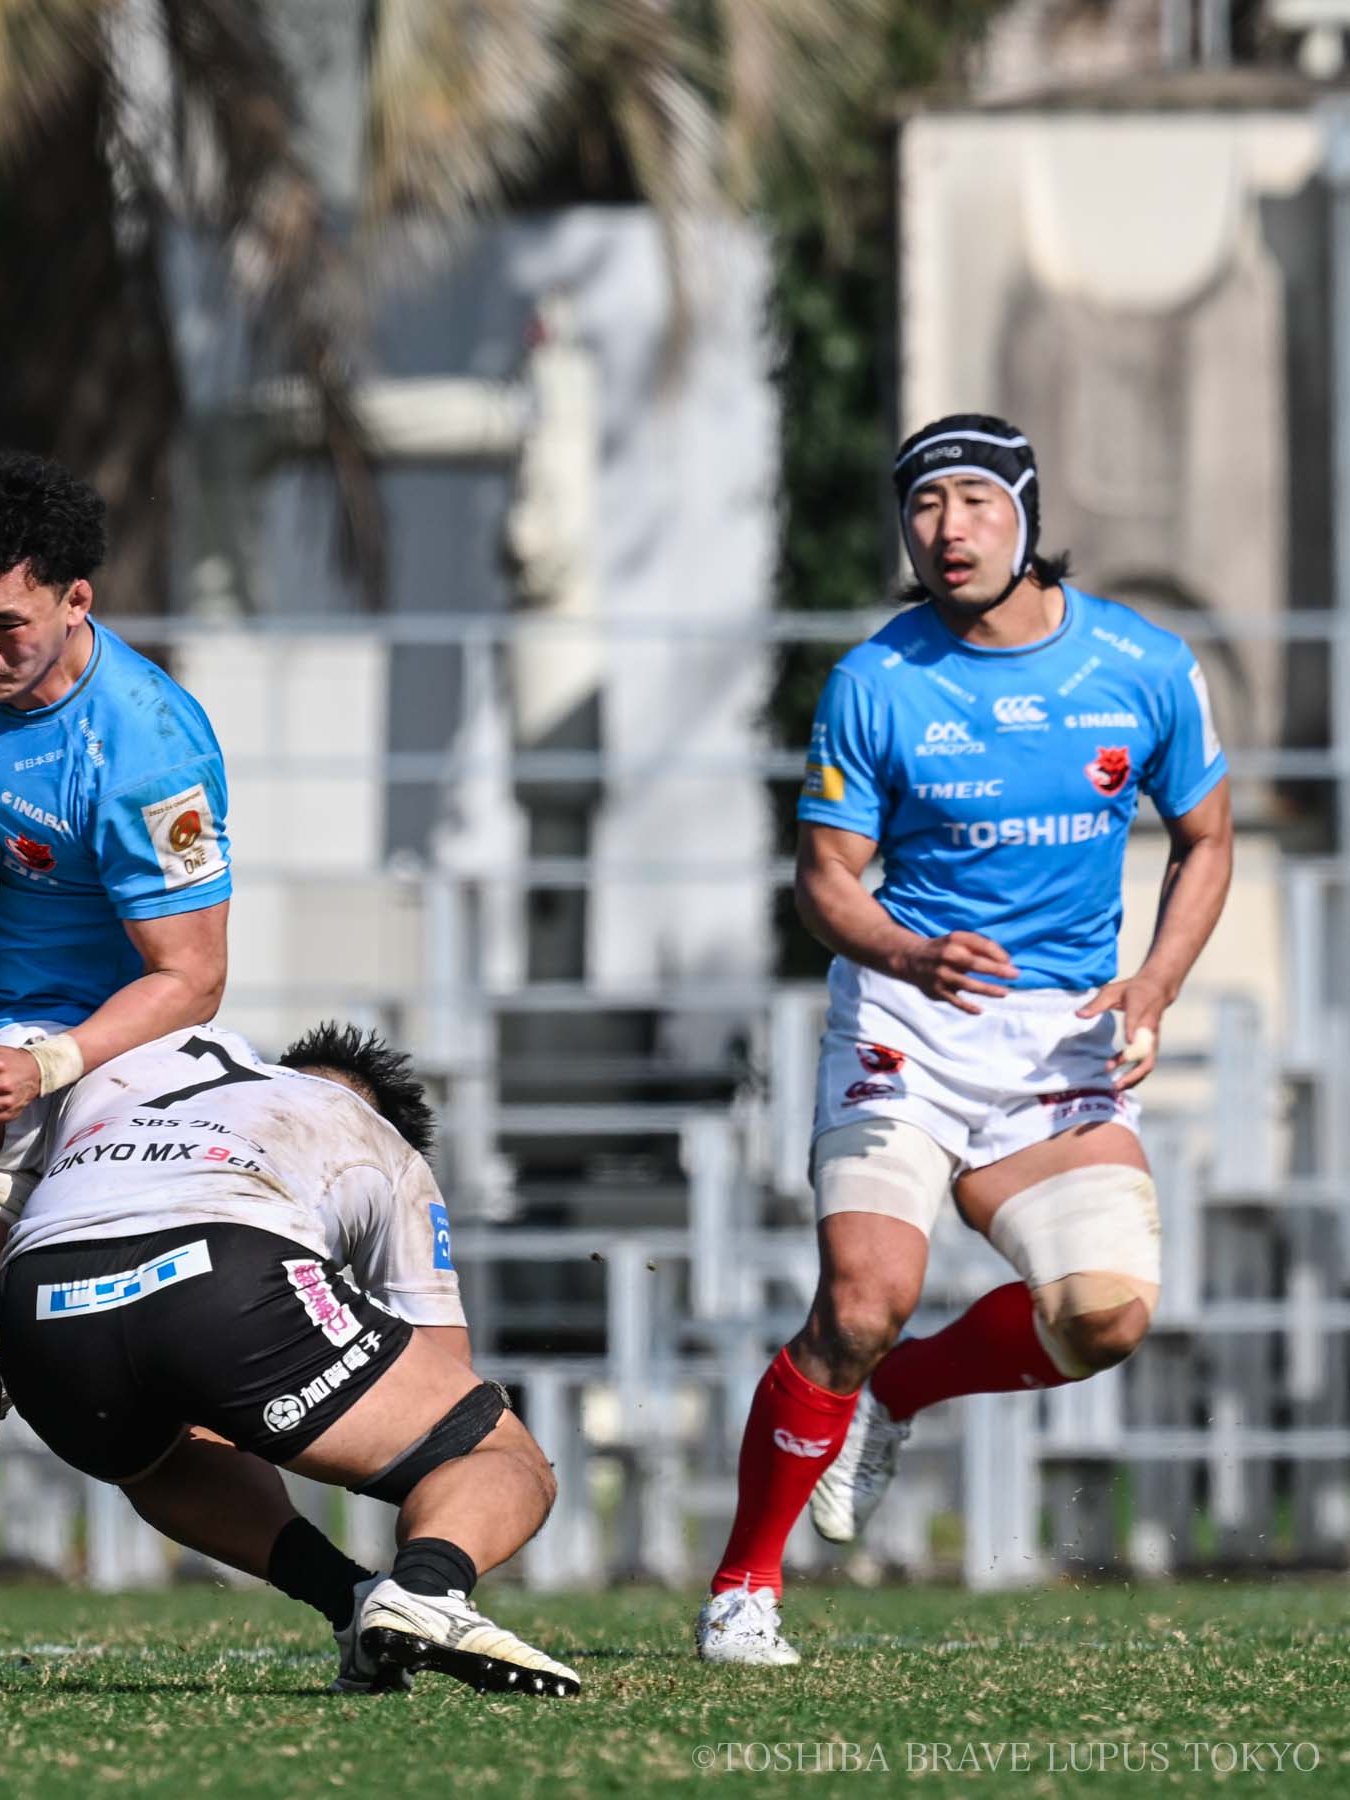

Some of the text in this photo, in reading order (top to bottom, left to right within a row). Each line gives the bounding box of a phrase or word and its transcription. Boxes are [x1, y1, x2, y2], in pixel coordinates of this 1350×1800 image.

[941, 810, 1110, 848] TOSHIBA
[138, 1035, 274, 1109] 7
[130, 1118, 182, 1127] SBS
[48, 1143, 136, 1178] OKYO
[141, 1143, 200, 1162] MX
